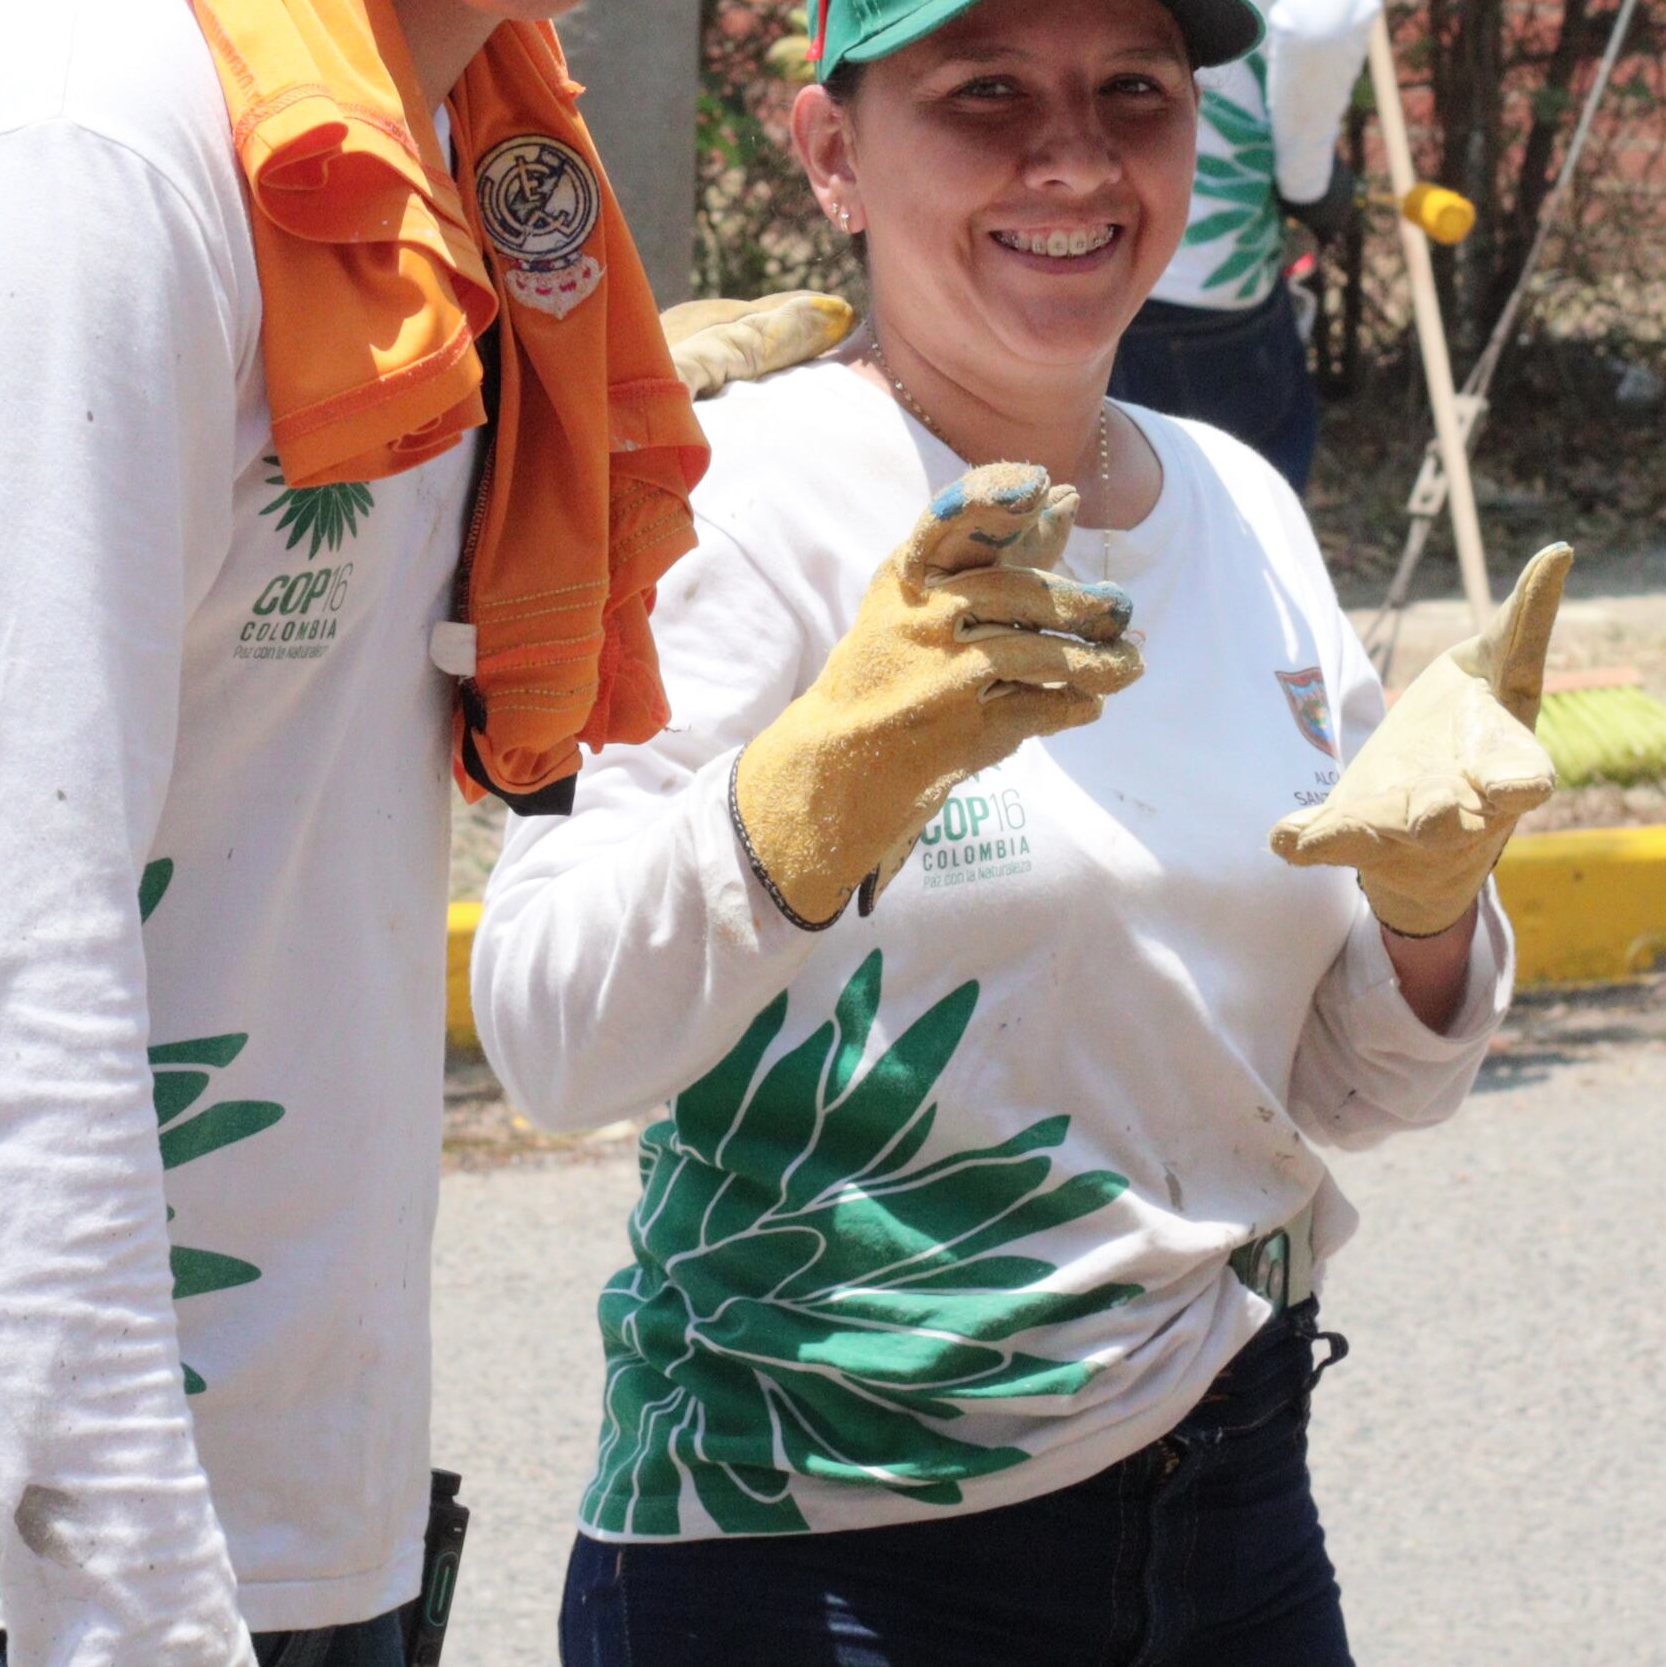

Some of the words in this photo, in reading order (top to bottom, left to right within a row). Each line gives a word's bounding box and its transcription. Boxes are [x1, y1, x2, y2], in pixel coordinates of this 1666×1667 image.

[252, 562, 354, 615] COP16
[239, 617, 337, 642] COLOMBIA
[923, 835, 1030, 872] COLOMBIA
